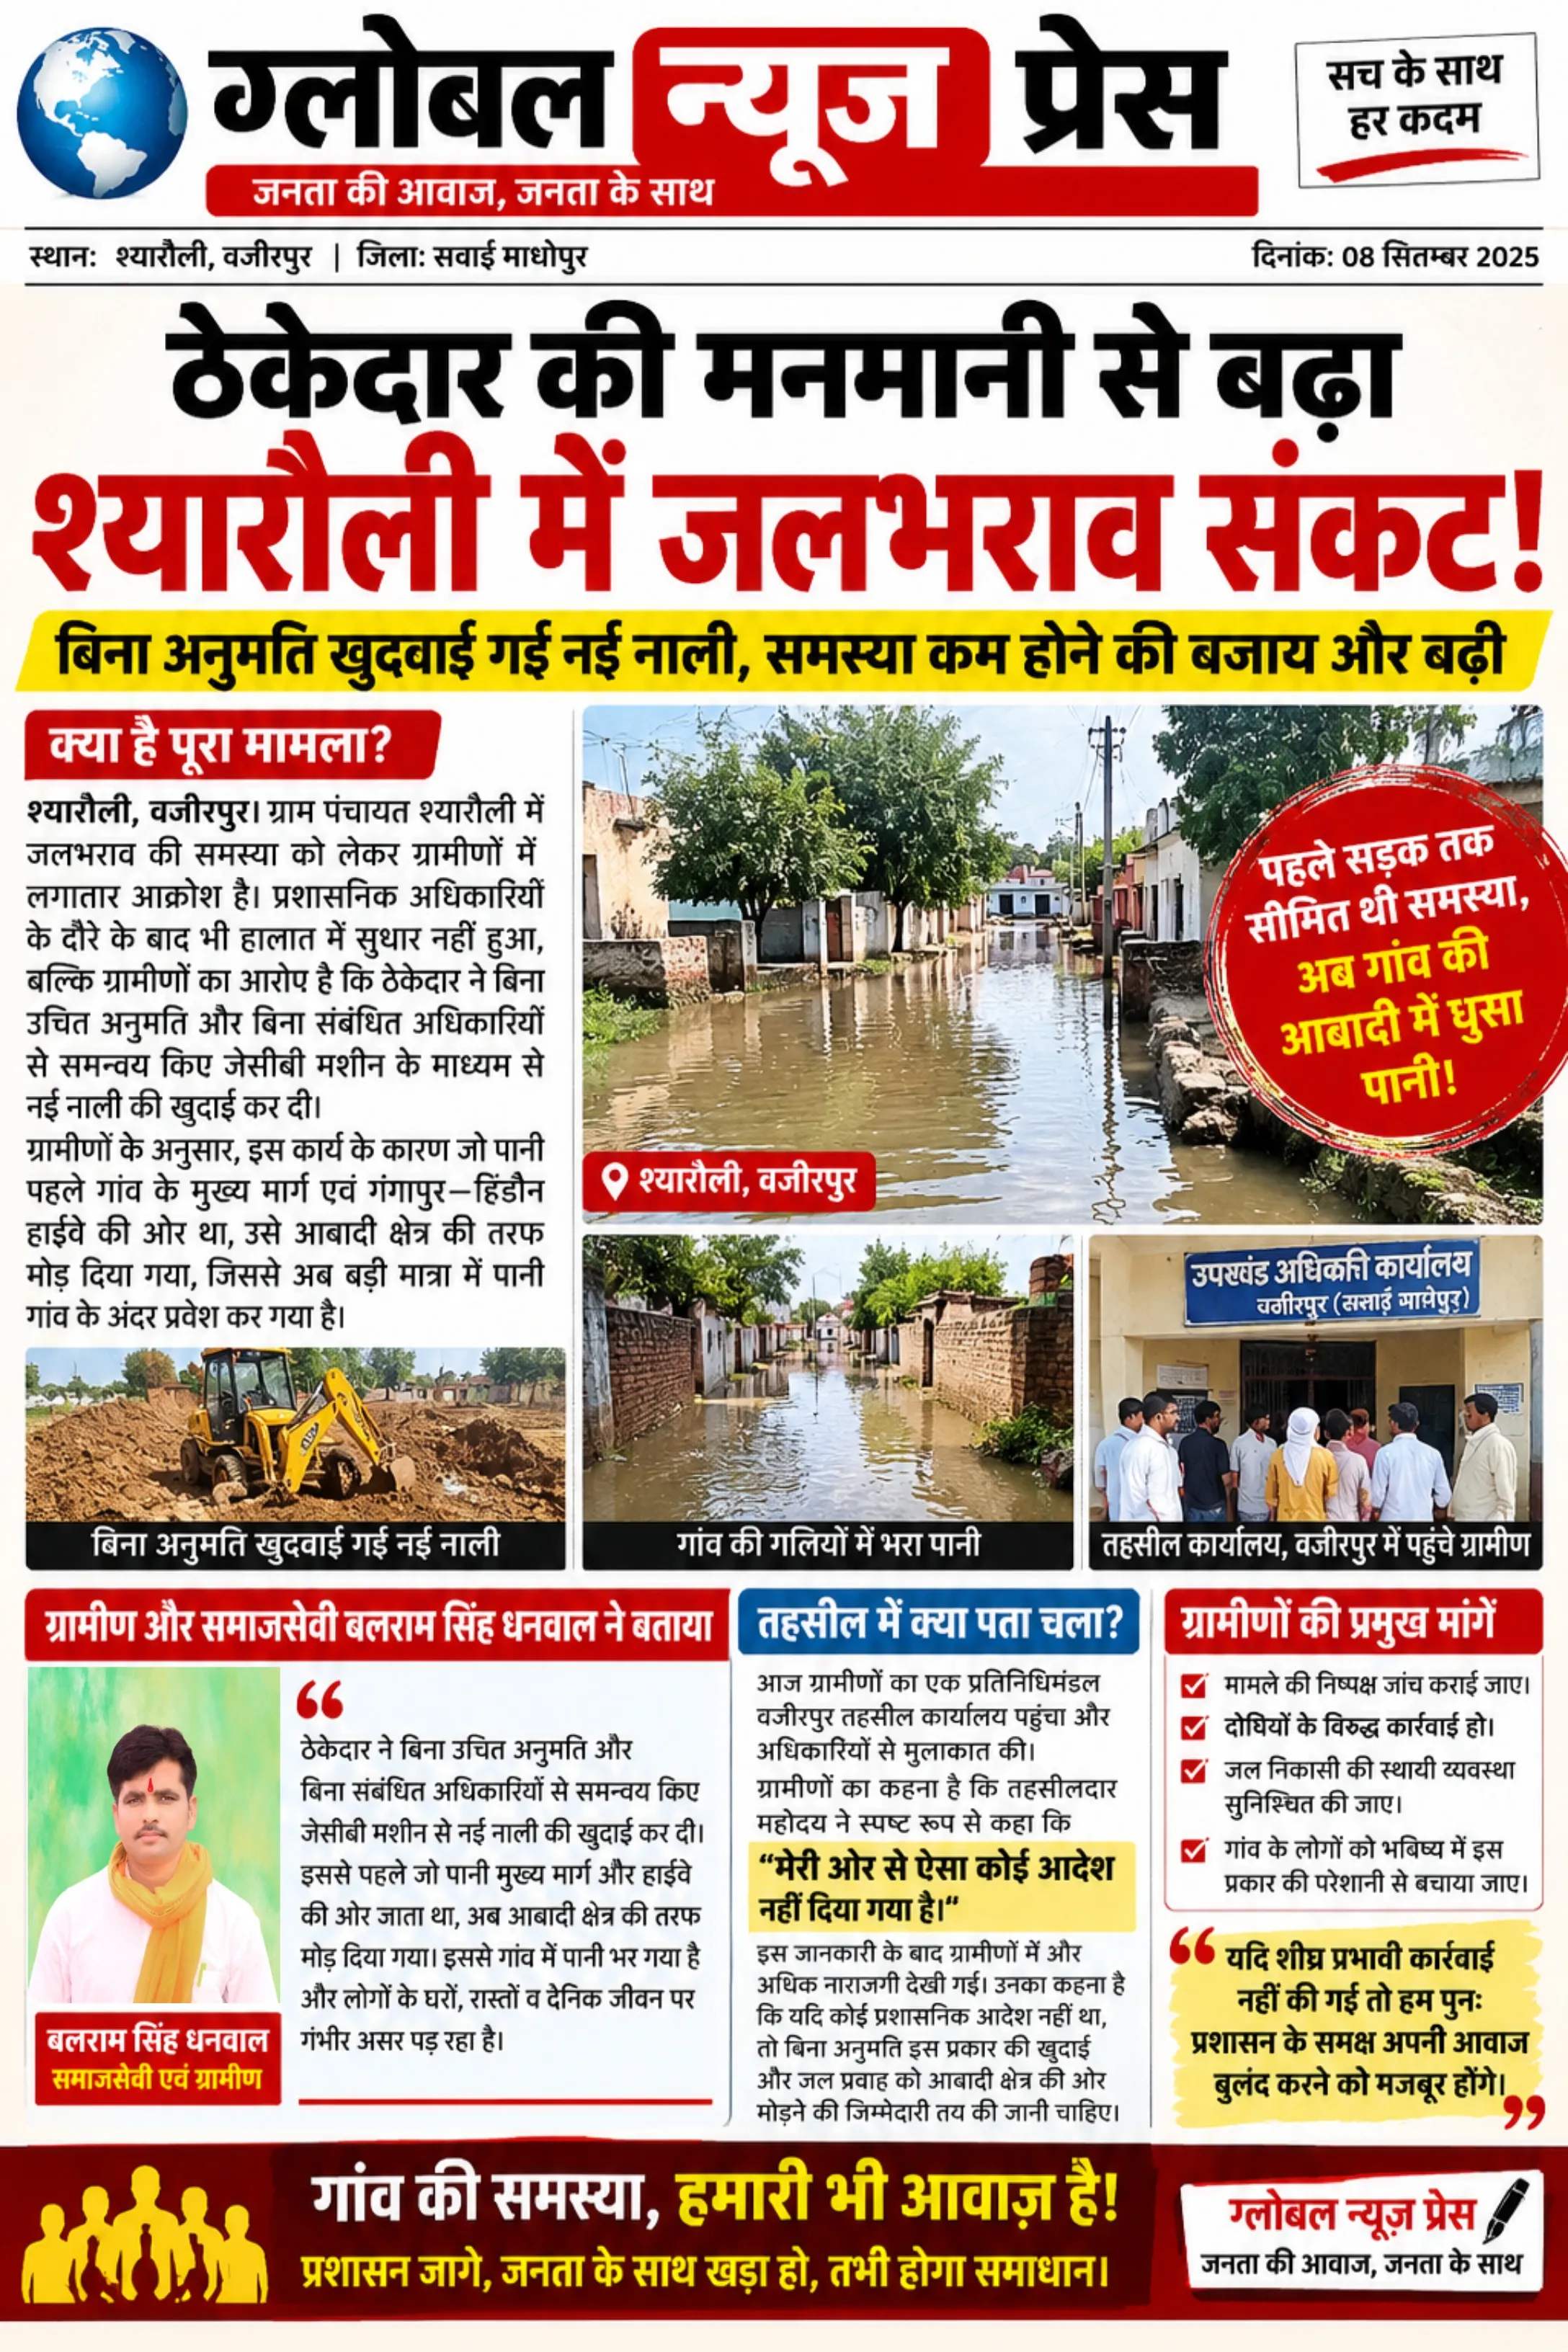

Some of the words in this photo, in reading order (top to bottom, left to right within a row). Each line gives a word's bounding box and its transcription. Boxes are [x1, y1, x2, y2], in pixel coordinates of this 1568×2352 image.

[1325, 59, 1385, 91] सच
[1391, 48, 1427, 88] के
[1433, 54, 1505, 86] साथ
[208, 13, 615, 149] ग्लोबल
[659, 47, 950, 187] न्यूज
[1015, 13, 1229, 154] प्रेस
[1347, 106, 1390, 141] हर
[1396, 102, 1483, 135] कदम
[251, 179, 339, 206] जनता
[345, 169, 390, 206] की
[397, 179, 507, 212] आवाज,
[514, 179, 600, 206] जनता
[607, 169, 641, 205] के
[649, 179, 716, 206] साथ
[28, 246, 96, 267] स्थान:
[115, 238, 215, 272] श्यारौली,
[221, 238, 313, 275] वजीरपुर
[356, 239, 425, 268] जिला:
[432, 239, 497, 271] सवाई
[501, 239, 589, 275] माधोपुर
[1251, 239, 1333, 269] दिनांक:
[1342, 246, 1375, 267] 08
[1381, 239, 1470, 268] सितम्बर
[1476, 246, 1539, 267] 2025
[164, 301, 513, 425] ठेकेदार
[529, 299, 676, 419] की
[695, 299, 1076, 419] मनमानी
[1093, 301, 1191, 419] से
[1209, 333, 1404, 443] बढ़ा
[32, 429, 491, 592] श्यारौली
[520, 432, 627, 592] में
[651, 473, 1175, 593] जलभराव
[1198, 437, 1543, 593] संकट!
[54, 619, 153, 675] बिना
[163, 619, 319, 692] अनुमति
[486, 618, 553, 681] गई
[561, 618, 623, 681] नई
[631, 619, 750, 683] नाली,
[763, 634, 918, 675] समस्या
[926, 634, 1012, 675] कम
[1019, 619, 1104, 680] होने
[1113, 619, 1179, 675] की
[1188, 634, 1320, 674] बजाय
[1331, 619, 1413, 675] और
[1420, 619, 1507, 685] बढ़ी
[48, 728, 123, 763] क्या
[130, 714, 160, 767] है
[168, 728, 233, 776] पूरा
[242, 724, 392, 763] मामला?
[27, 791, 139, 828] श्यारौली,
[266, 801, 316, 824] ग्राम
[322, 793, 411, 824] पंचायत
[419, 791, 517, 824] श्यारौली
[523, 792, 545, 824] में
[1257, 839, 1336, 888] पहले
[1342, 834, 1429, 878] सड़क
[1434, 824, 1494, 862] तक
[25, 886, 122, 909] लगातार
[132, 876, 223, 909] आक्रोश
[272, 877, 399, 909] प्रशासनिक
[409, 876, 545, 909] अधिकारियों
[1244, 895, 1351, 944] सीमित
[1359, 883, 1399, 926] थी
[1404, 875, 1529, 919] समस्या,
[1297, 955, 1355, 993] अब
[1362, 938, 1431, 984] गांव
[1438, 925, 1489, 973] की
[1280, 997, 1401, 1056] आबादी
[1407, 992, 1440, 1037] में
[1360, 1052, 1457, 1105] पानी!
[25, 1087, 61, 1123] नई
[65, 1087, 123, 1119] नाली
[128, 1087, 164, 1119] की
[169, 1087, 237, 1128] खुदाई
[242, 1096, 281, 1119] कर
[639, 1159, 749, 1198] श्यारौली,
[757, 1159, 858, 1203] वजीरपुर
[676, 1526, 723, 1556] गांव
[729, 1525, 765, 1556] की
[769, 1525, 849, 1556] गलियों
[854, 1525, 876, 1556] में
[880, 1533, 924, 1556] भरा
[927, 1525, 982, 1556] पानी
[1100, 1525, 1183, 1560] तहसील
[1186, 1524, 1288, 1562] कार्यालय,
[1293, 1525, 1378, 1566] वजीरपुर
[1381, 1525, 1402, 1557] में
[1404, 1524, 1456, 1565] पहुंचे
[1460, 1525, 1532, 1557] ग्रामीण
[44, 1600, 138, 1643] ग्रामीण
[144, 1598, 196, 1642] और
[200, 1599, 339, 1642] समाजसेवी
[343, 1611, 437, 1642] बलराम
[442, 1599, 496, 1645] सिंह
[502, 1611, 599, 1642] धनवाल
[603, 1599, 626, 1642] ने
[631, 1611, 714, 1642] बताया
[757, 1596, 870, 1642] तहसील
[876, 1596, 904, 1639] में
[909, 1608, 969, 1639] क्या
[974, 1608, 1033, 1639] पता
[1038, 1604, 1123, 1639] चला?
[1180, 1596, 1293, 1639] ग्रामीणों
[1298, 1596, 1342, 1639] की
[1348, 1607, 1430, 1649] प्रमुख
[1435, 1596, 1497, 1639] मांगें
[757, 1674, 803, 1693] आज
[808, 1667, 883, 1693] ग्रामीणों
[889, 1675, 919, 1693] का
[924, 1675, 961, 1694] एक
[967, 1667, 1101, 1693] प्रतिनिधिमंडल
[1224, 1670, 1280, 1695] मामले
[1284, 1670, 1311, 1695] की
[1382, 1671, 1425, 1695] जांच
[1428, 1670, 1479, 1698] कराई
[300, 1734, 373, 1762] ठेकेदार
[377, 1733, 394, 1760] ने
[399, 1733, 446, 1760] बिना
[451, 1734, 507, 1760] उचित
[513, 1734, 589, 1768] अनुमति
[594, 1733, 633, 1760] और
[1224, 1940, 1270, 1972] यदि
[1330, 1940, 1404, 1971] प्रभावी
[1408, 1939, 1496, 1974] कार्रवाई
[46, 2029, 128, 2053] बलराम
[131, 2021, 180, 2055] सिंह
[186, 2029, 270, 2053] धनवाल
[51, 2062, 153, 2090] समाजसेवी
[158, 2063, 190, 2090] एवं
[194, 2062, 263, 2090] ग्रामीण
[311, 2161, 405, 2222] गांव
[414, 2157, 481, 2221] की
[491, 2173, 659, 2230] समस्या,
[674, 2157, 814, 2227] हमारी
[826, 2157, 889, 2220] भी
[901, 2174, 1057, 2230] आवाज़
[1065, 2157, 1118, 2227] है!
[1228, 2188, 1340, 2231] ग्लोबल
[1345, 2199, 1417, 2241] न्यूज़
[1422, 2188, 1478, 2231] प्रेस
